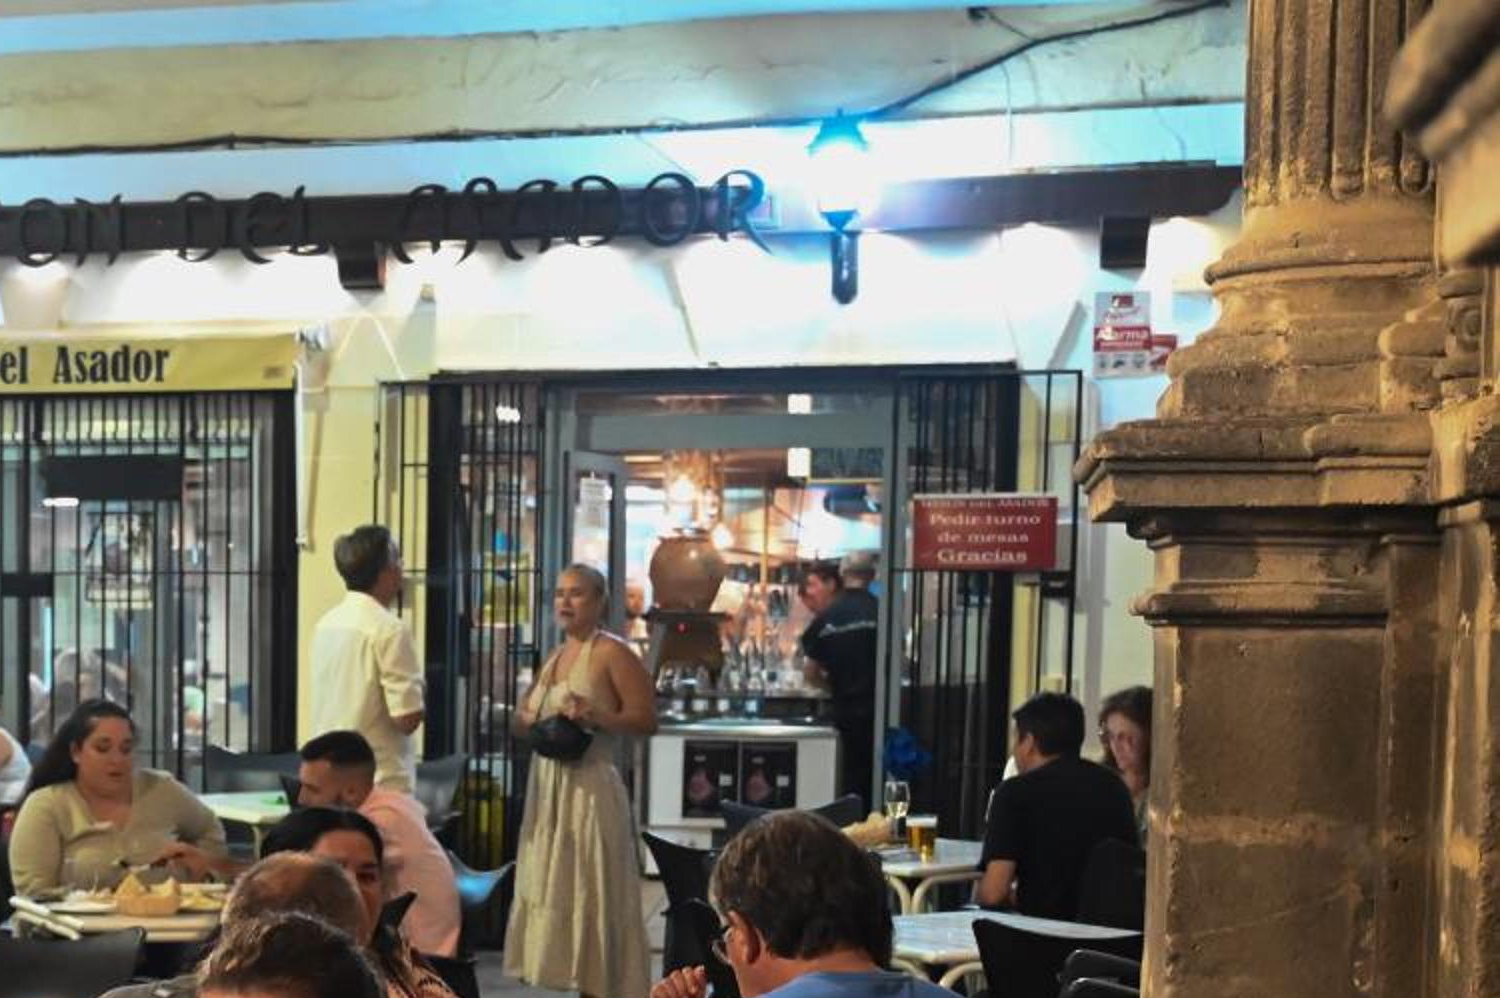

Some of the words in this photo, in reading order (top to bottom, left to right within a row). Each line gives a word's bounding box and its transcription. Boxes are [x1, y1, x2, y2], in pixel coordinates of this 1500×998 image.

[1097, 328, 1148, 341] Aarma
[53, 344, 169, 384] Asador
[930, 513, 981, 525] Pedir
[986, 514, 1041, 525] turno
[937, 532, 960, 543] de
[968, 533, 1029, 543] mesas
[937, 548, 1028, 562] Gracias
